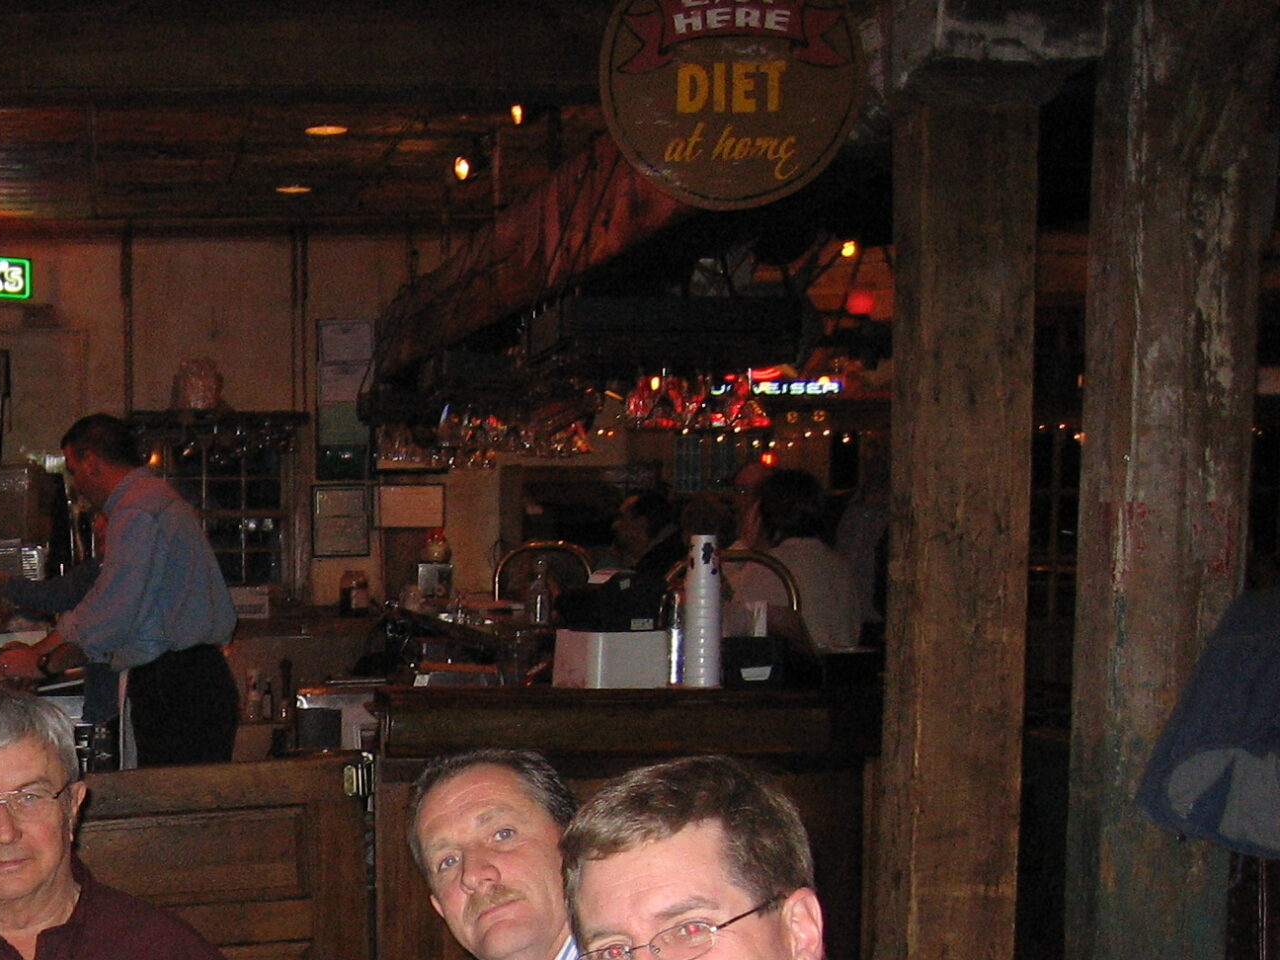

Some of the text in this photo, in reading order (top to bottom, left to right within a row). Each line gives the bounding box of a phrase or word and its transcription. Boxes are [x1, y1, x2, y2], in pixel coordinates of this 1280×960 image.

[673, 7, 791, 35] HERE
[676, 61, 788, 114] DIET
[664, 121, 800, 181] at home
